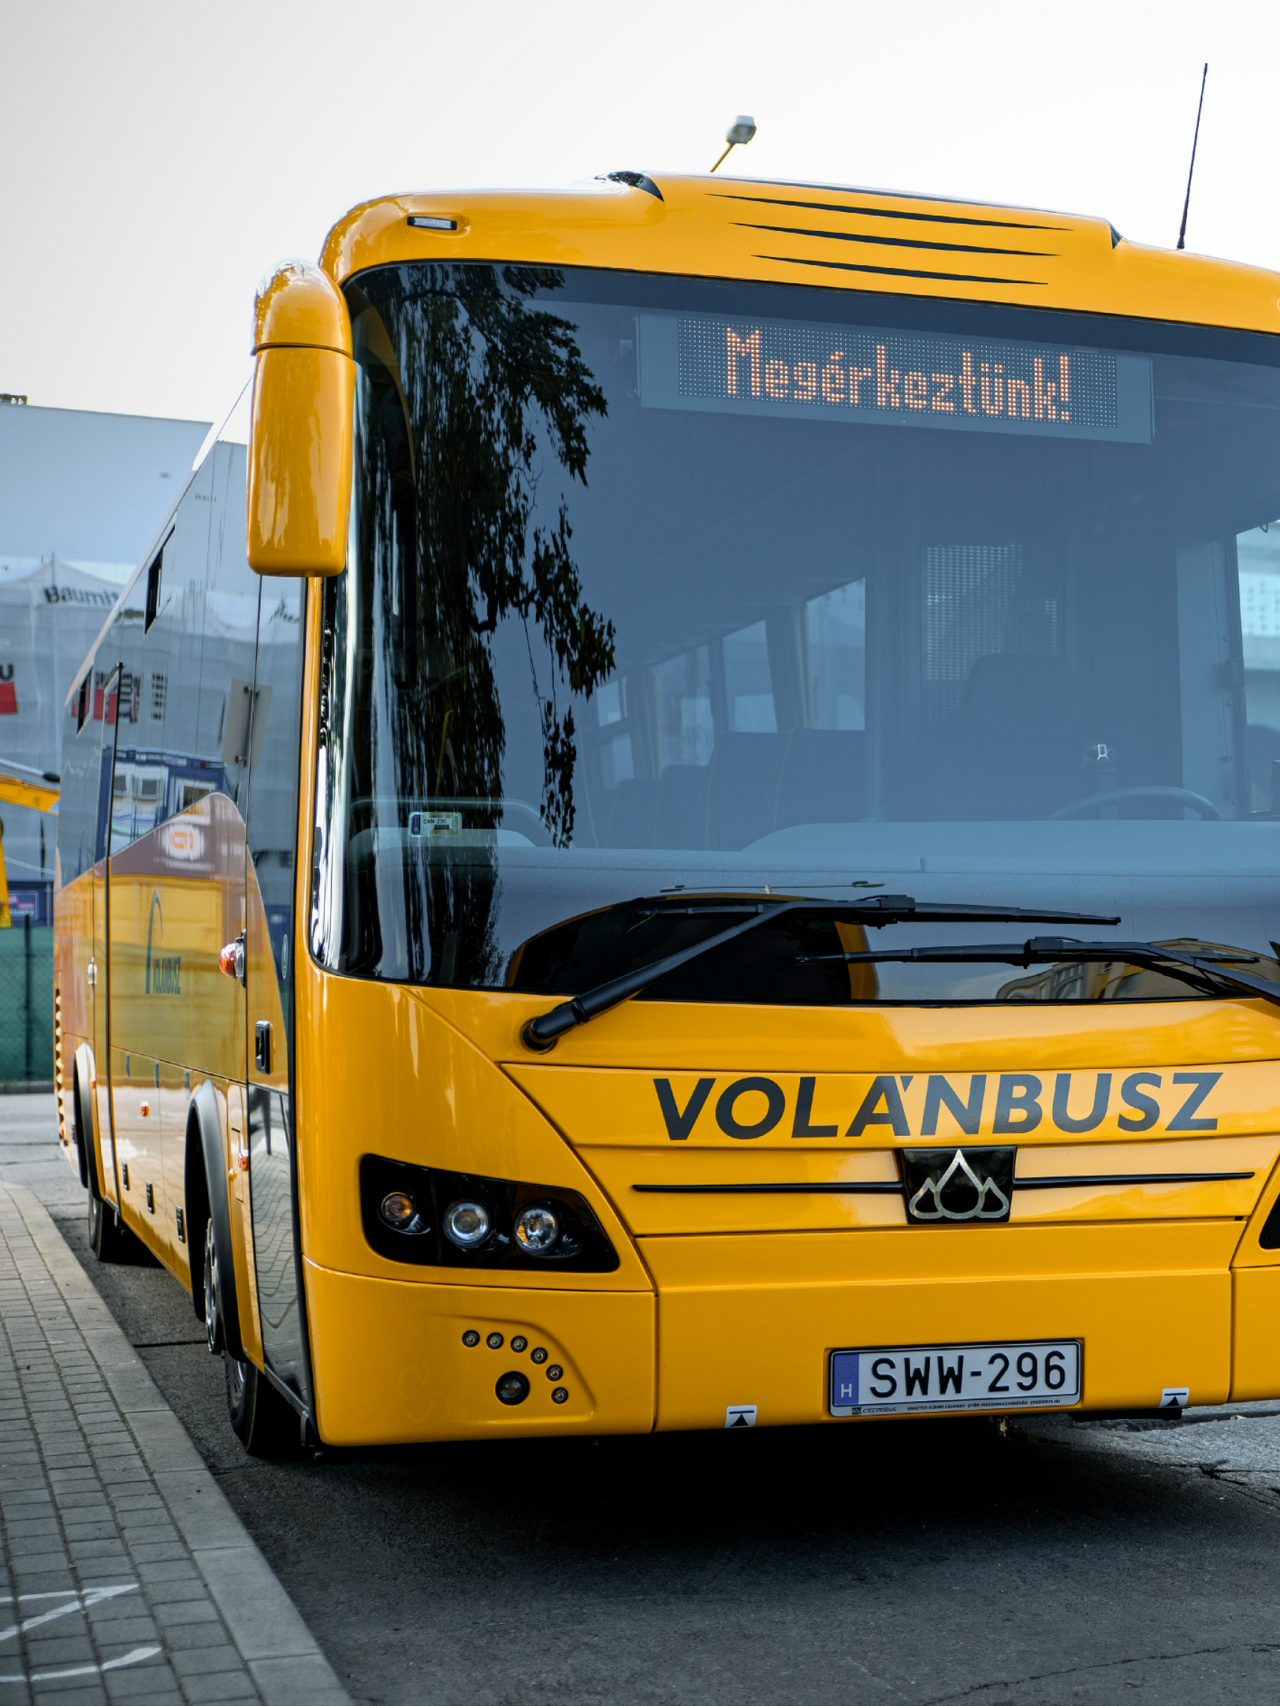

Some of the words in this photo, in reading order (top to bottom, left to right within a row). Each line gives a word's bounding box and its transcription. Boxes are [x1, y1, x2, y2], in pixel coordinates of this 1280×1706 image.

[727, 327, 1071, 421] Megérkeztünk!
[652, 1072, 1223, 1141] VOLÁNBUSZ
[869, 1350, 1067, 1398] SWW-296
